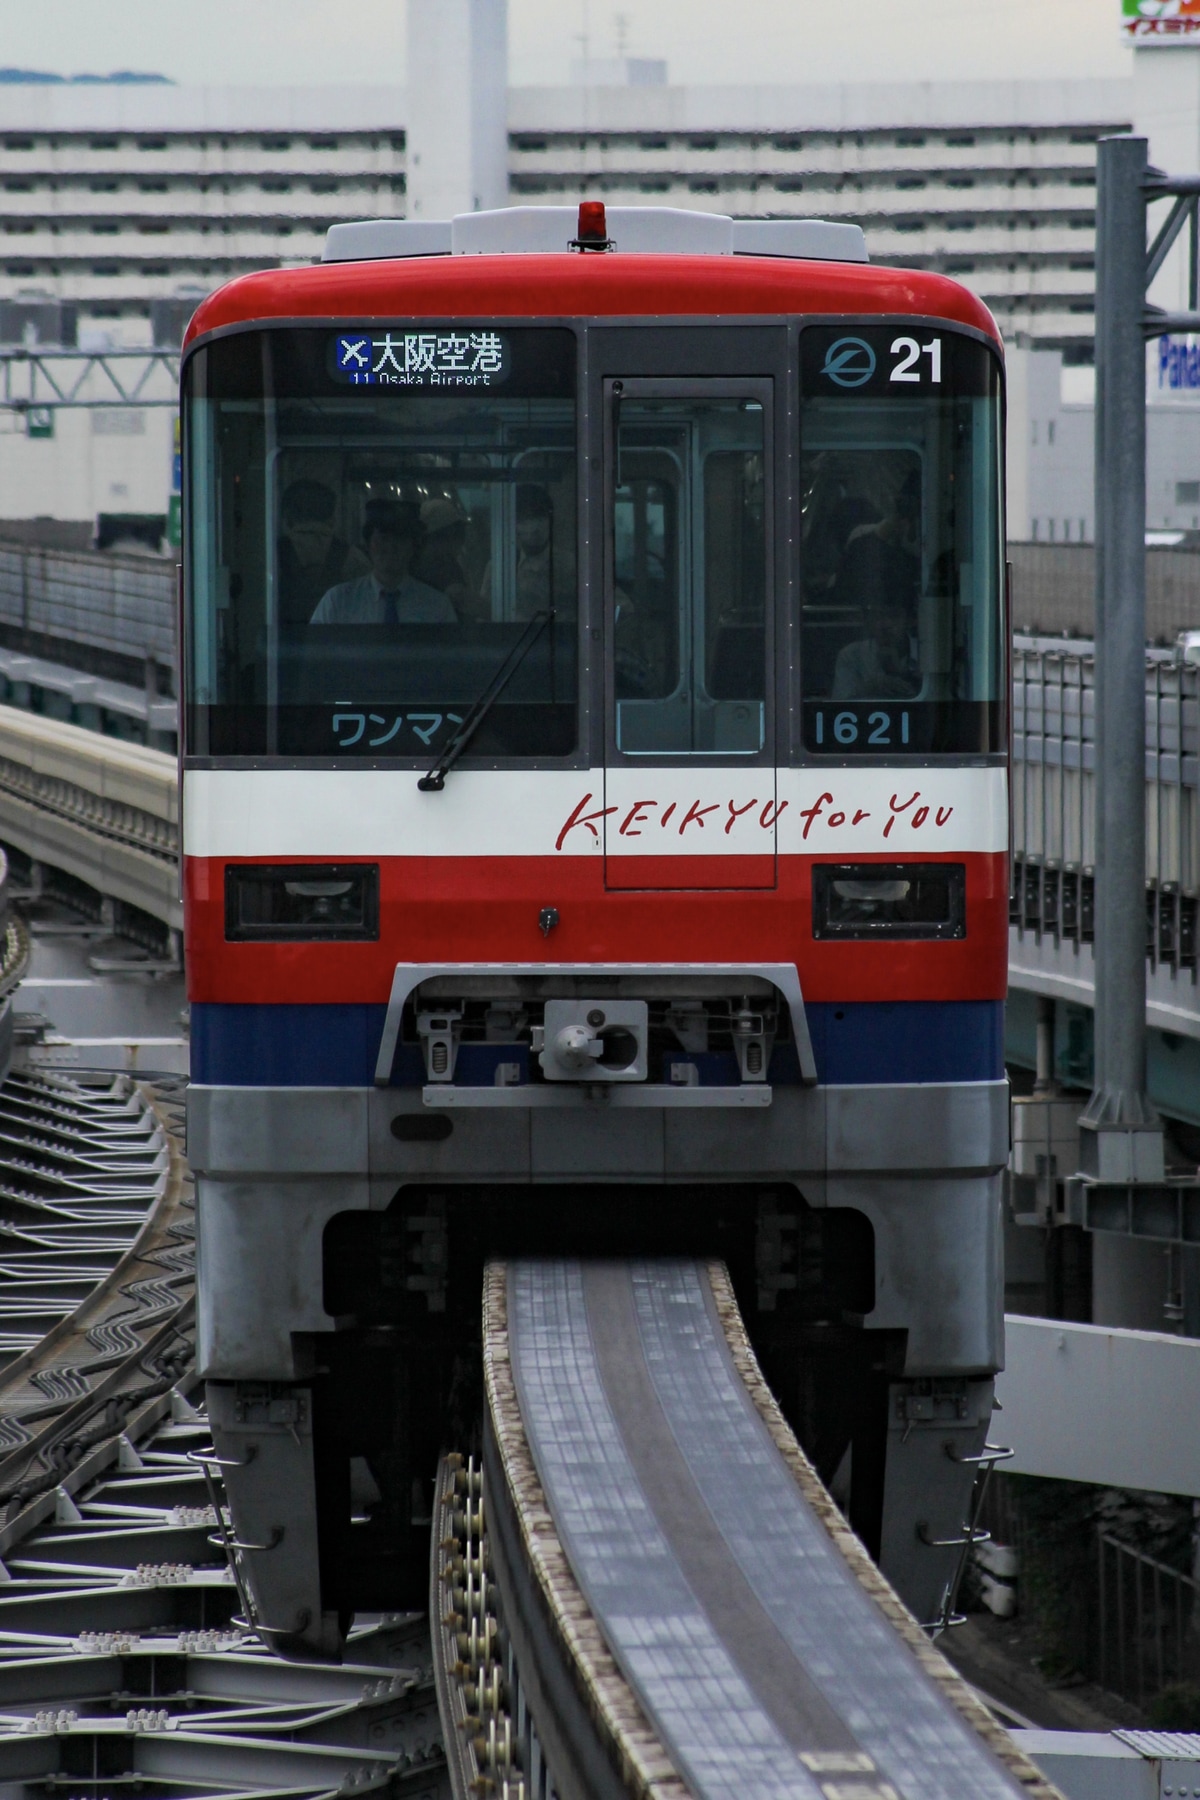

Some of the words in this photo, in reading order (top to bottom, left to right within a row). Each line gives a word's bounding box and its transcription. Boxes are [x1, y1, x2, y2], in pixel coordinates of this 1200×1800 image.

[372, 333, 502, 372] 大阪空港
[889, 336, 942, 383] 21
[353, 372, 370, 385] 11
[379, 372, 423, 385] Osaka
[430, 372, 490, 386] Airport
[816, 711, 909, 744] 1621
[555, 793, 788, 850] KEIKYU
[800, 792, 871, 840] for
[883, 791, 954, 838] You
